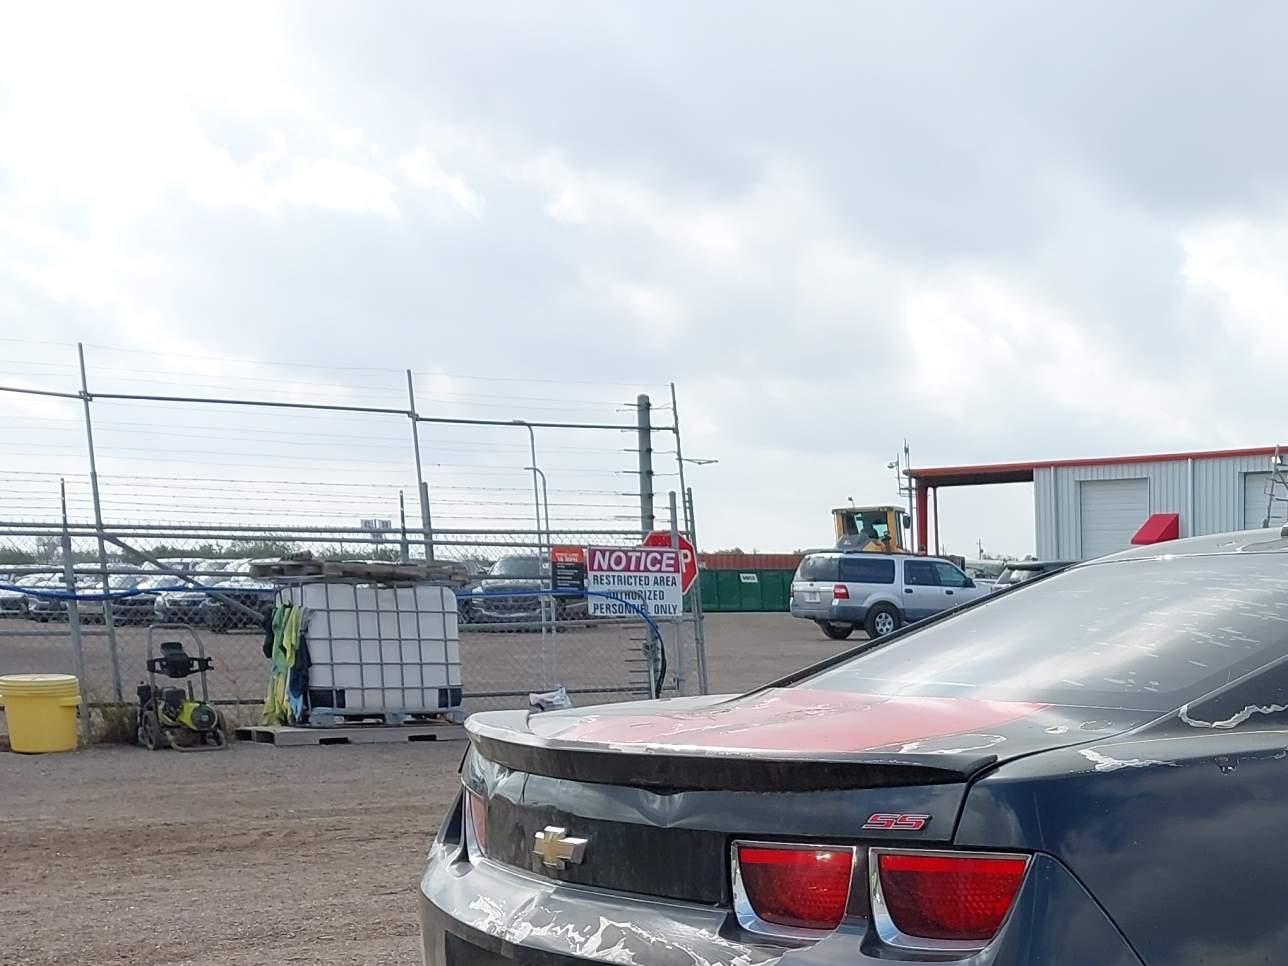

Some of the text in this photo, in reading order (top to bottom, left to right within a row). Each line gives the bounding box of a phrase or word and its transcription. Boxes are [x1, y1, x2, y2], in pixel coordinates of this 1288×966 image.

[593, 550, 676, 571] NOTICE
[593, 575, 677, 587] RESTRICTED AREA
[593, 603, 679, 615] PERSONNEL ONLY
[861, 813, 931, 830] SS
